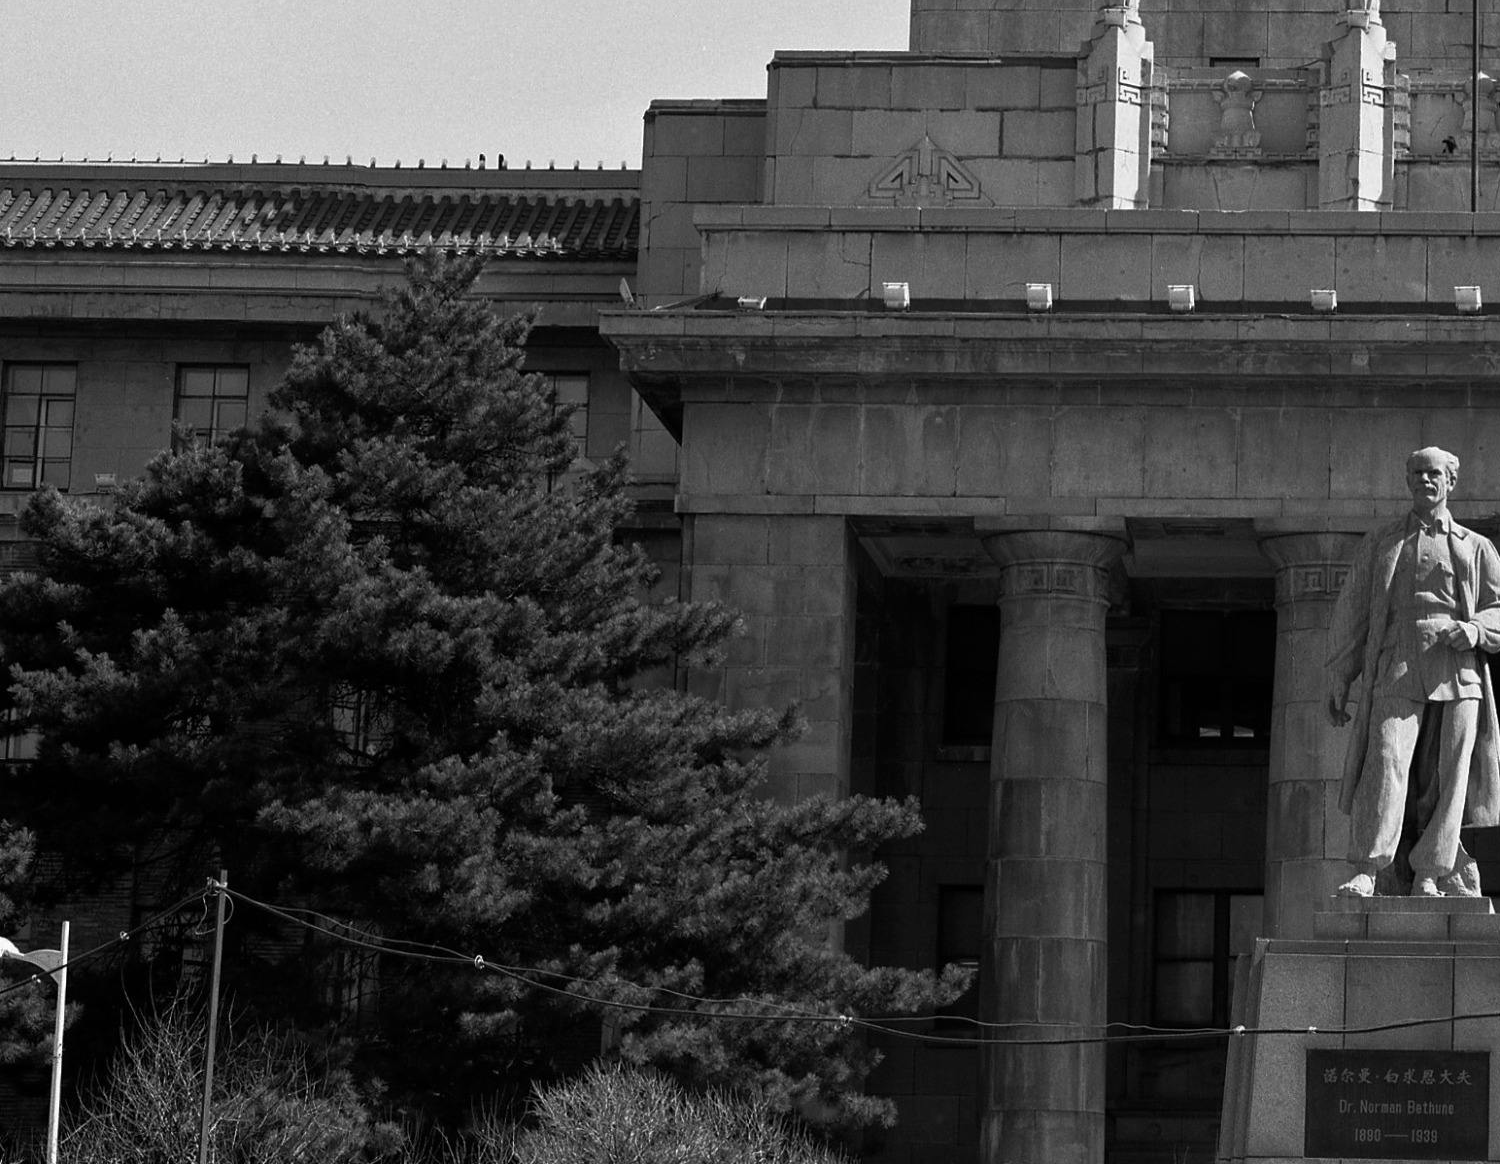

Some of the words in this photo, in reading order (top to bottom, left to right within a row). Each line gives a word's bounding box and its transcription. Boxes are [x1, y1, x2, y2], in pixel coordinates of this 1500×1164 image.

[1323, 1067, 1472, 1085] 诺尔曼·白求恩大夫
[1339, 1099, 1357, 1114] Dr.
[1359, 1100, 1402, 1114] Norman
[1407, 1100, 1455, 1115] Bethune
